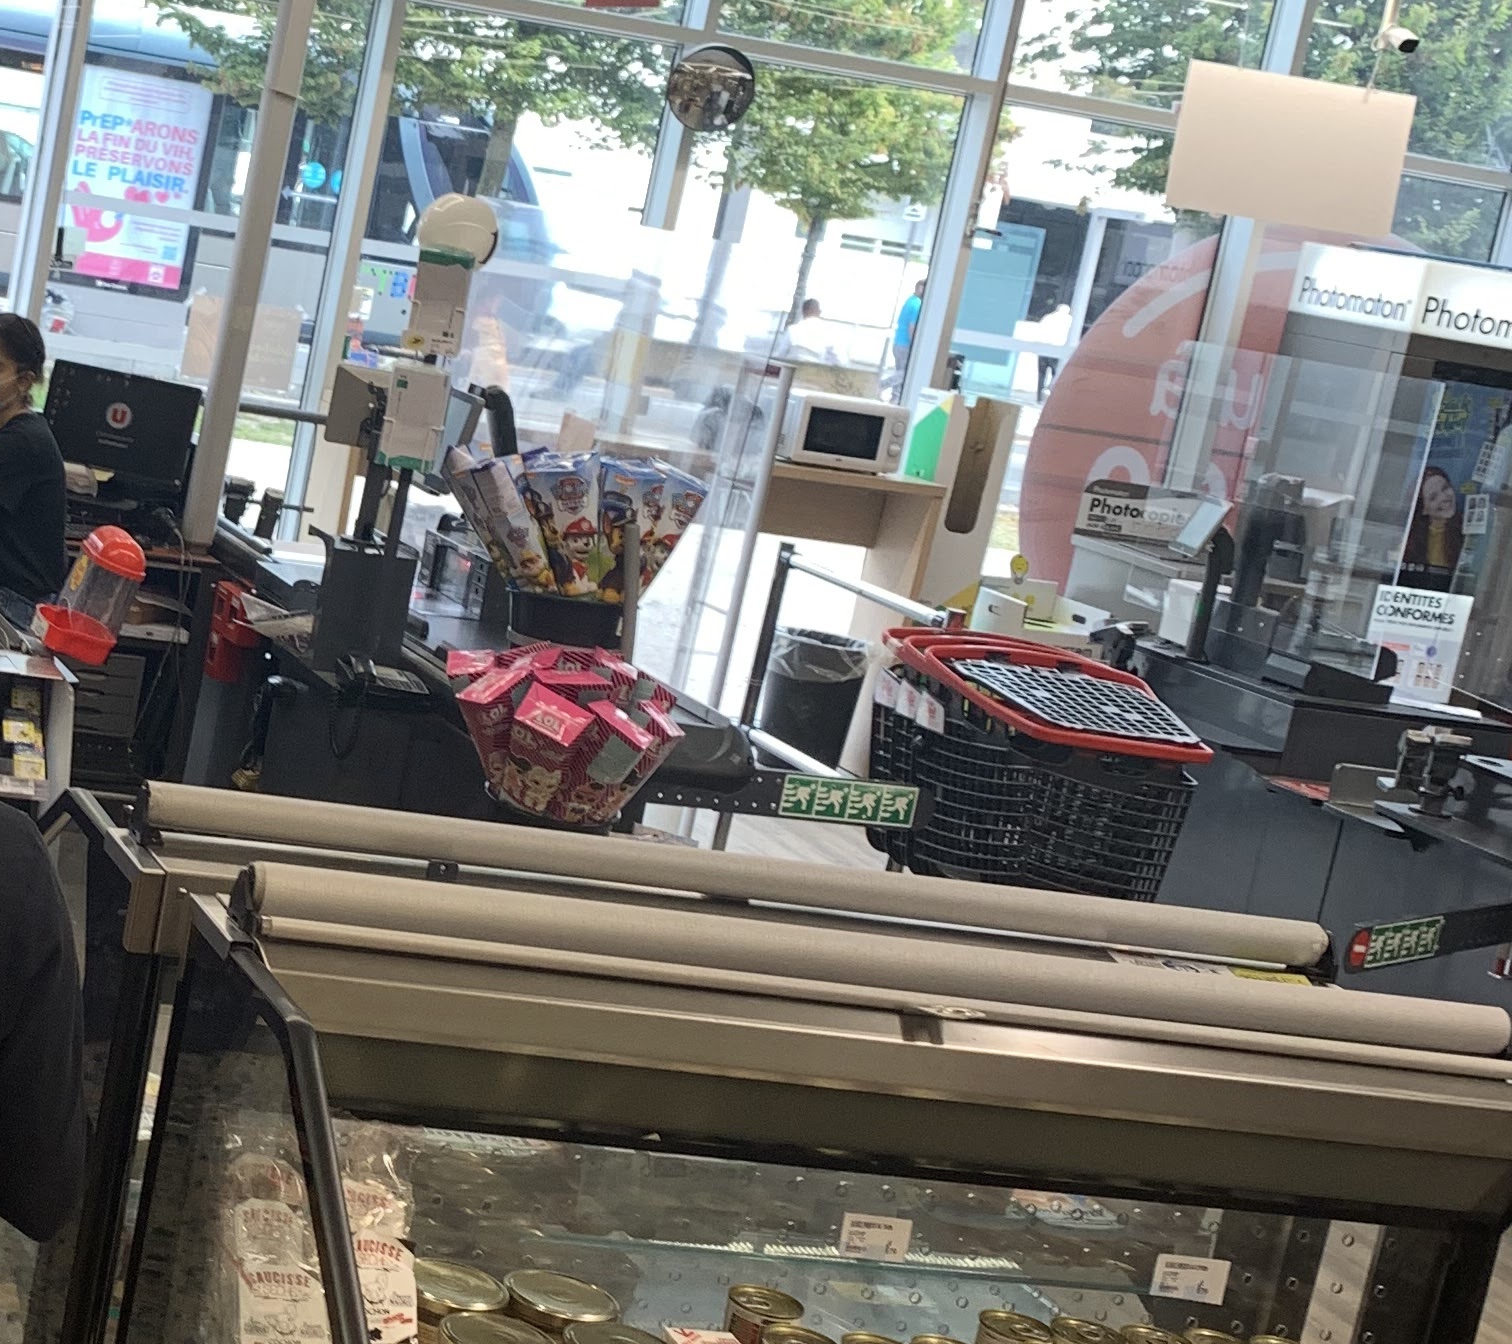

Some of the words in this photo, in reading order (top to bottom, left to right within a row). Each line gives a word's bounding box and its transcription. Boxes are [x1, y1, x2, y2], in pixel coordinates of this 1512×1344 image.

[77, 128, 98, 144] LA
[102, 133, 130, 149] FIN
[134, 136, 157, 153] DU
[72, 159, 97, 178] LE
[1298, 275, 1407, 321] Photomaton
[112, 408, 127, 424] U
[355, 1239, 403, 1262] AUCISSE
[250, 1270, 311, 1289] SAUCISSE
